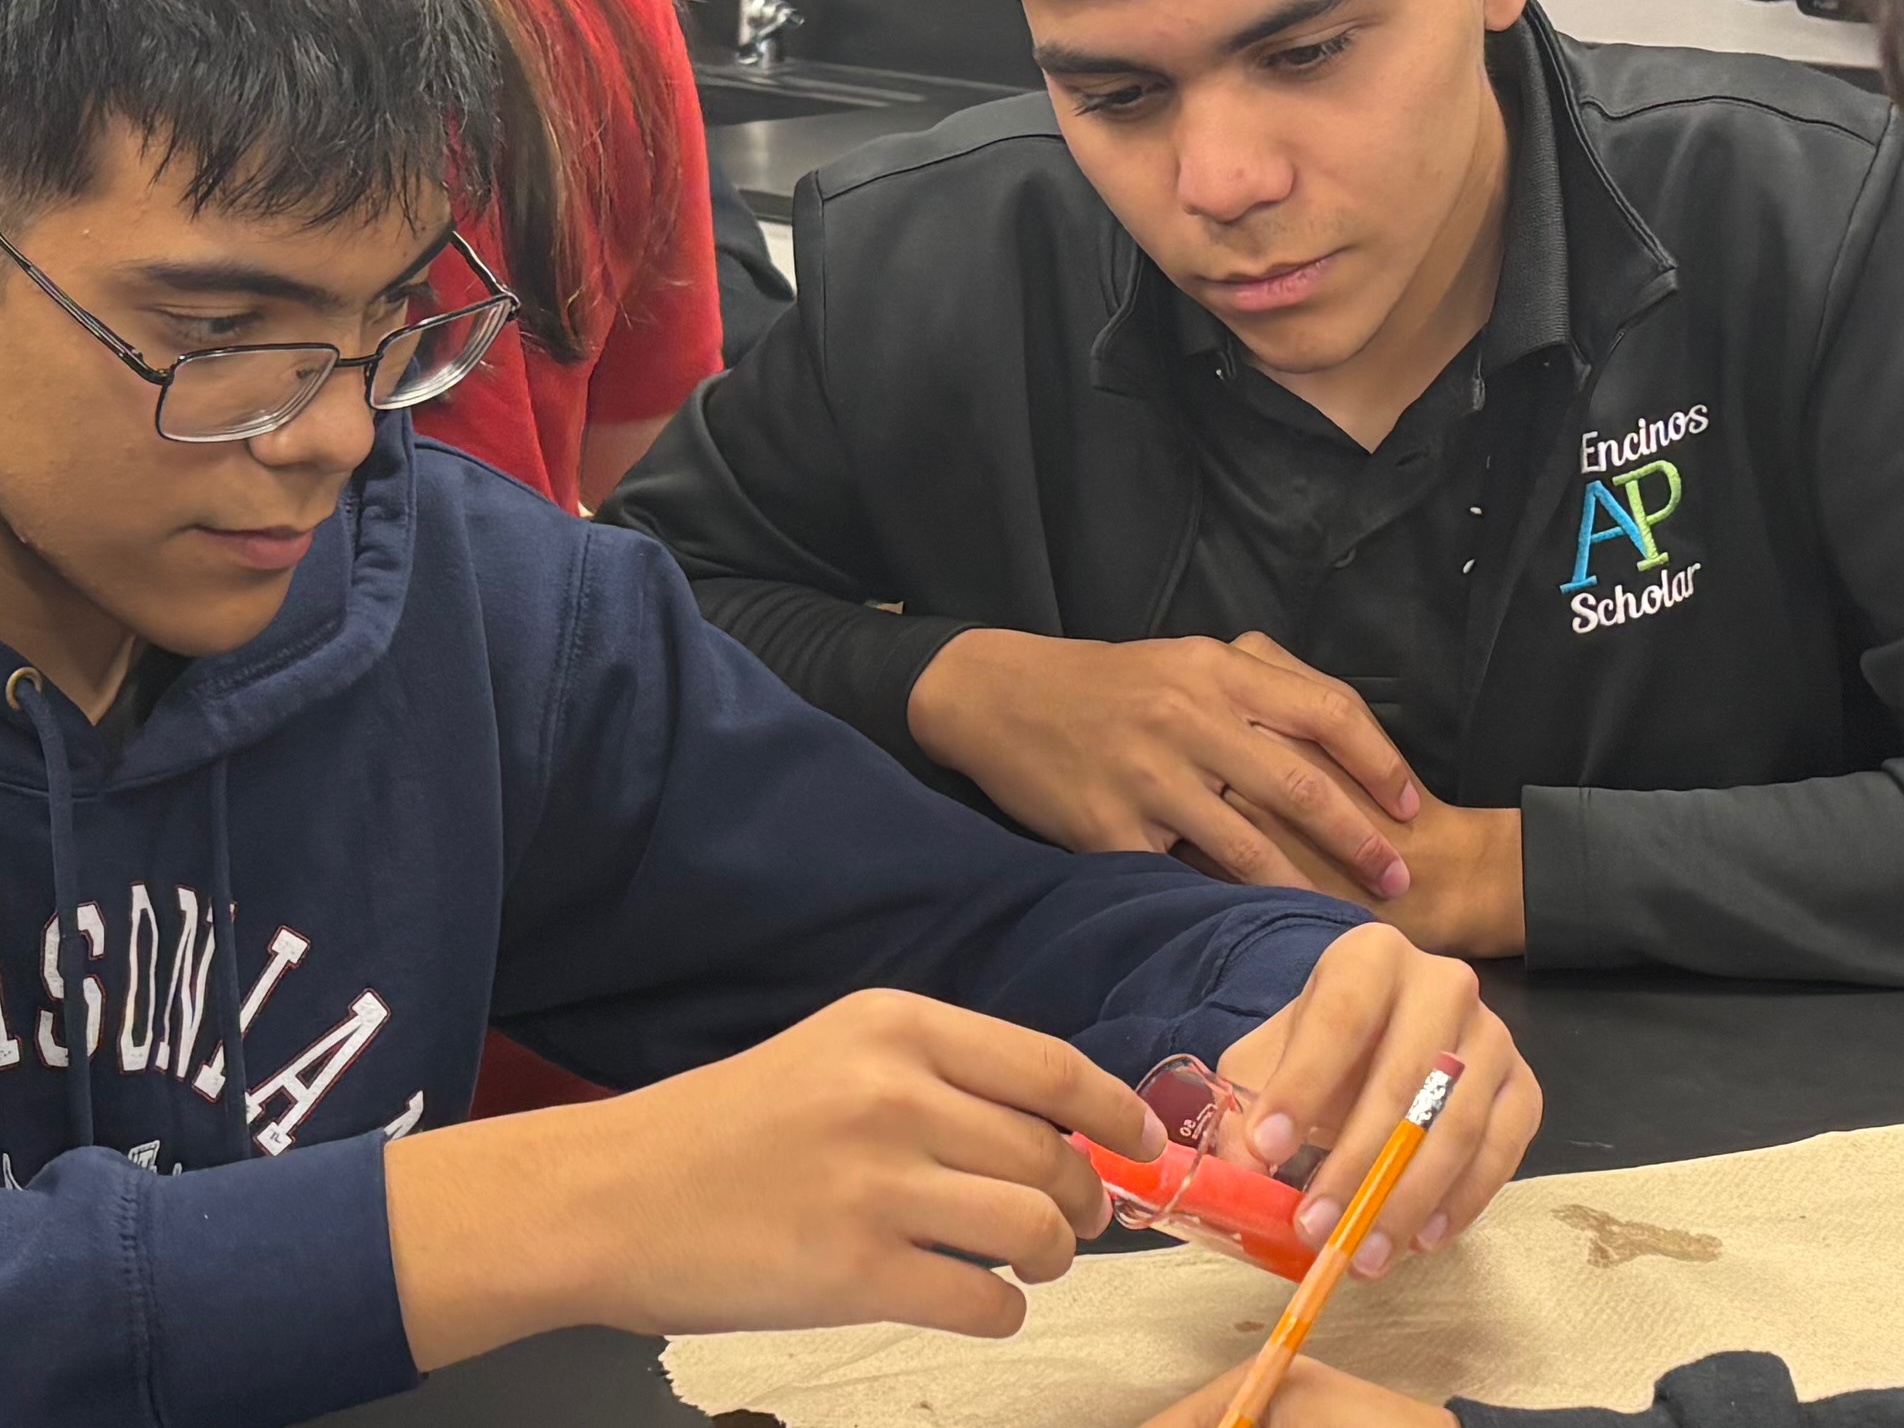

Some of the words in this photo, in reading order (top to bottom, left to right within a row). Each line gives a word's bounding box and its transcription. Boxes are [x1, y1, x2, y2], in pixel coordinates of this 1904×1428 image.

[1580, 404, 1710, 474] Encinos
[1559, 459, 1682, 595] AP
[1571, 562, 1702, 634] Scholar
